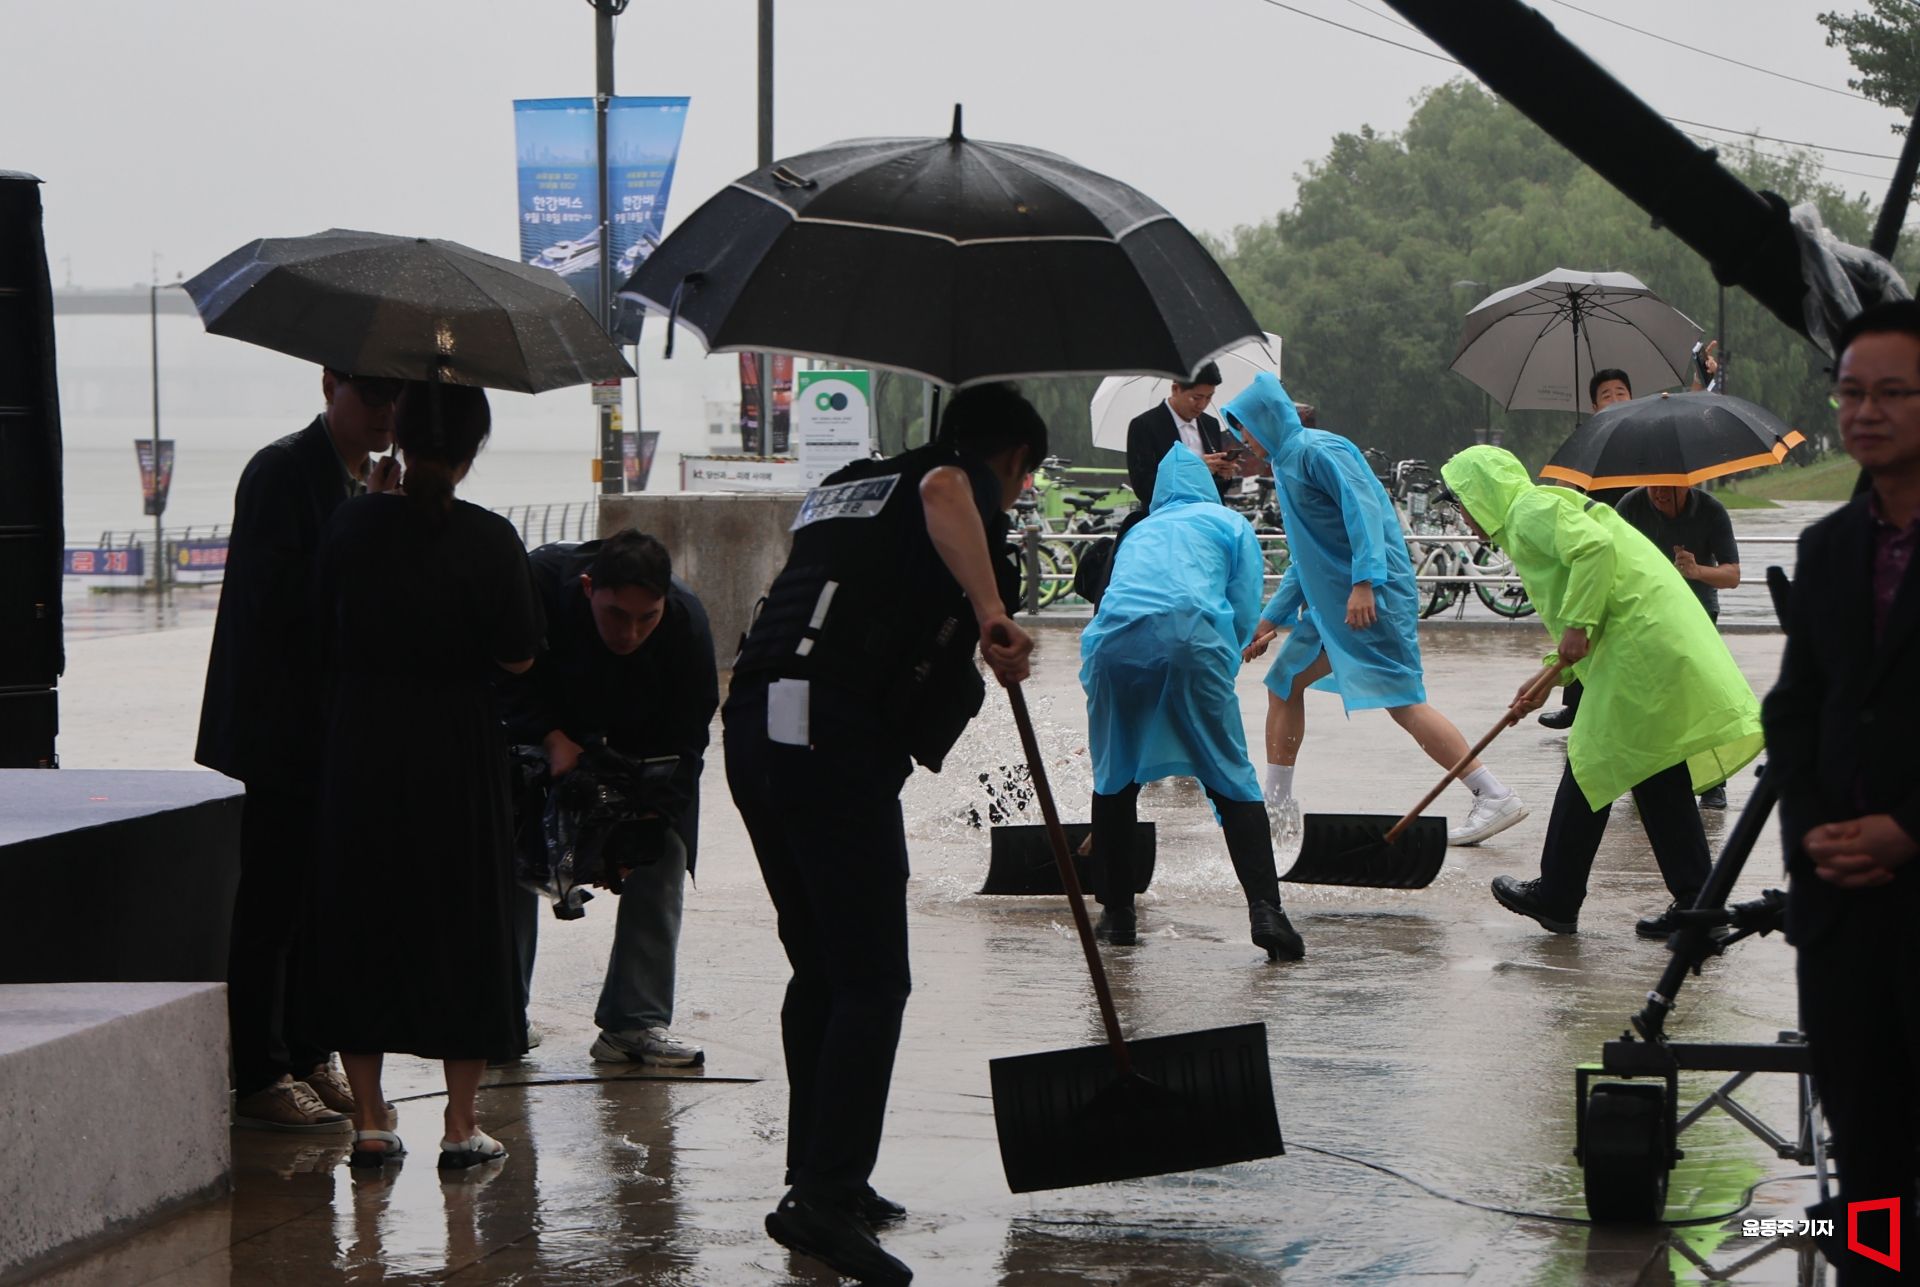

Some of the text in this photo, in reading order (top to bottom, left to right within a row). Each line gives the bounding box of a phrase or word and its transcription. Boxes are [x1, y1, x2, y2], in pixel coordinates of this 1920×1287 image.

[533, 196, 583, 211] 한강버스
[524, 213, 540, 224] 9월
[542, 213, 561, 224] 18일
